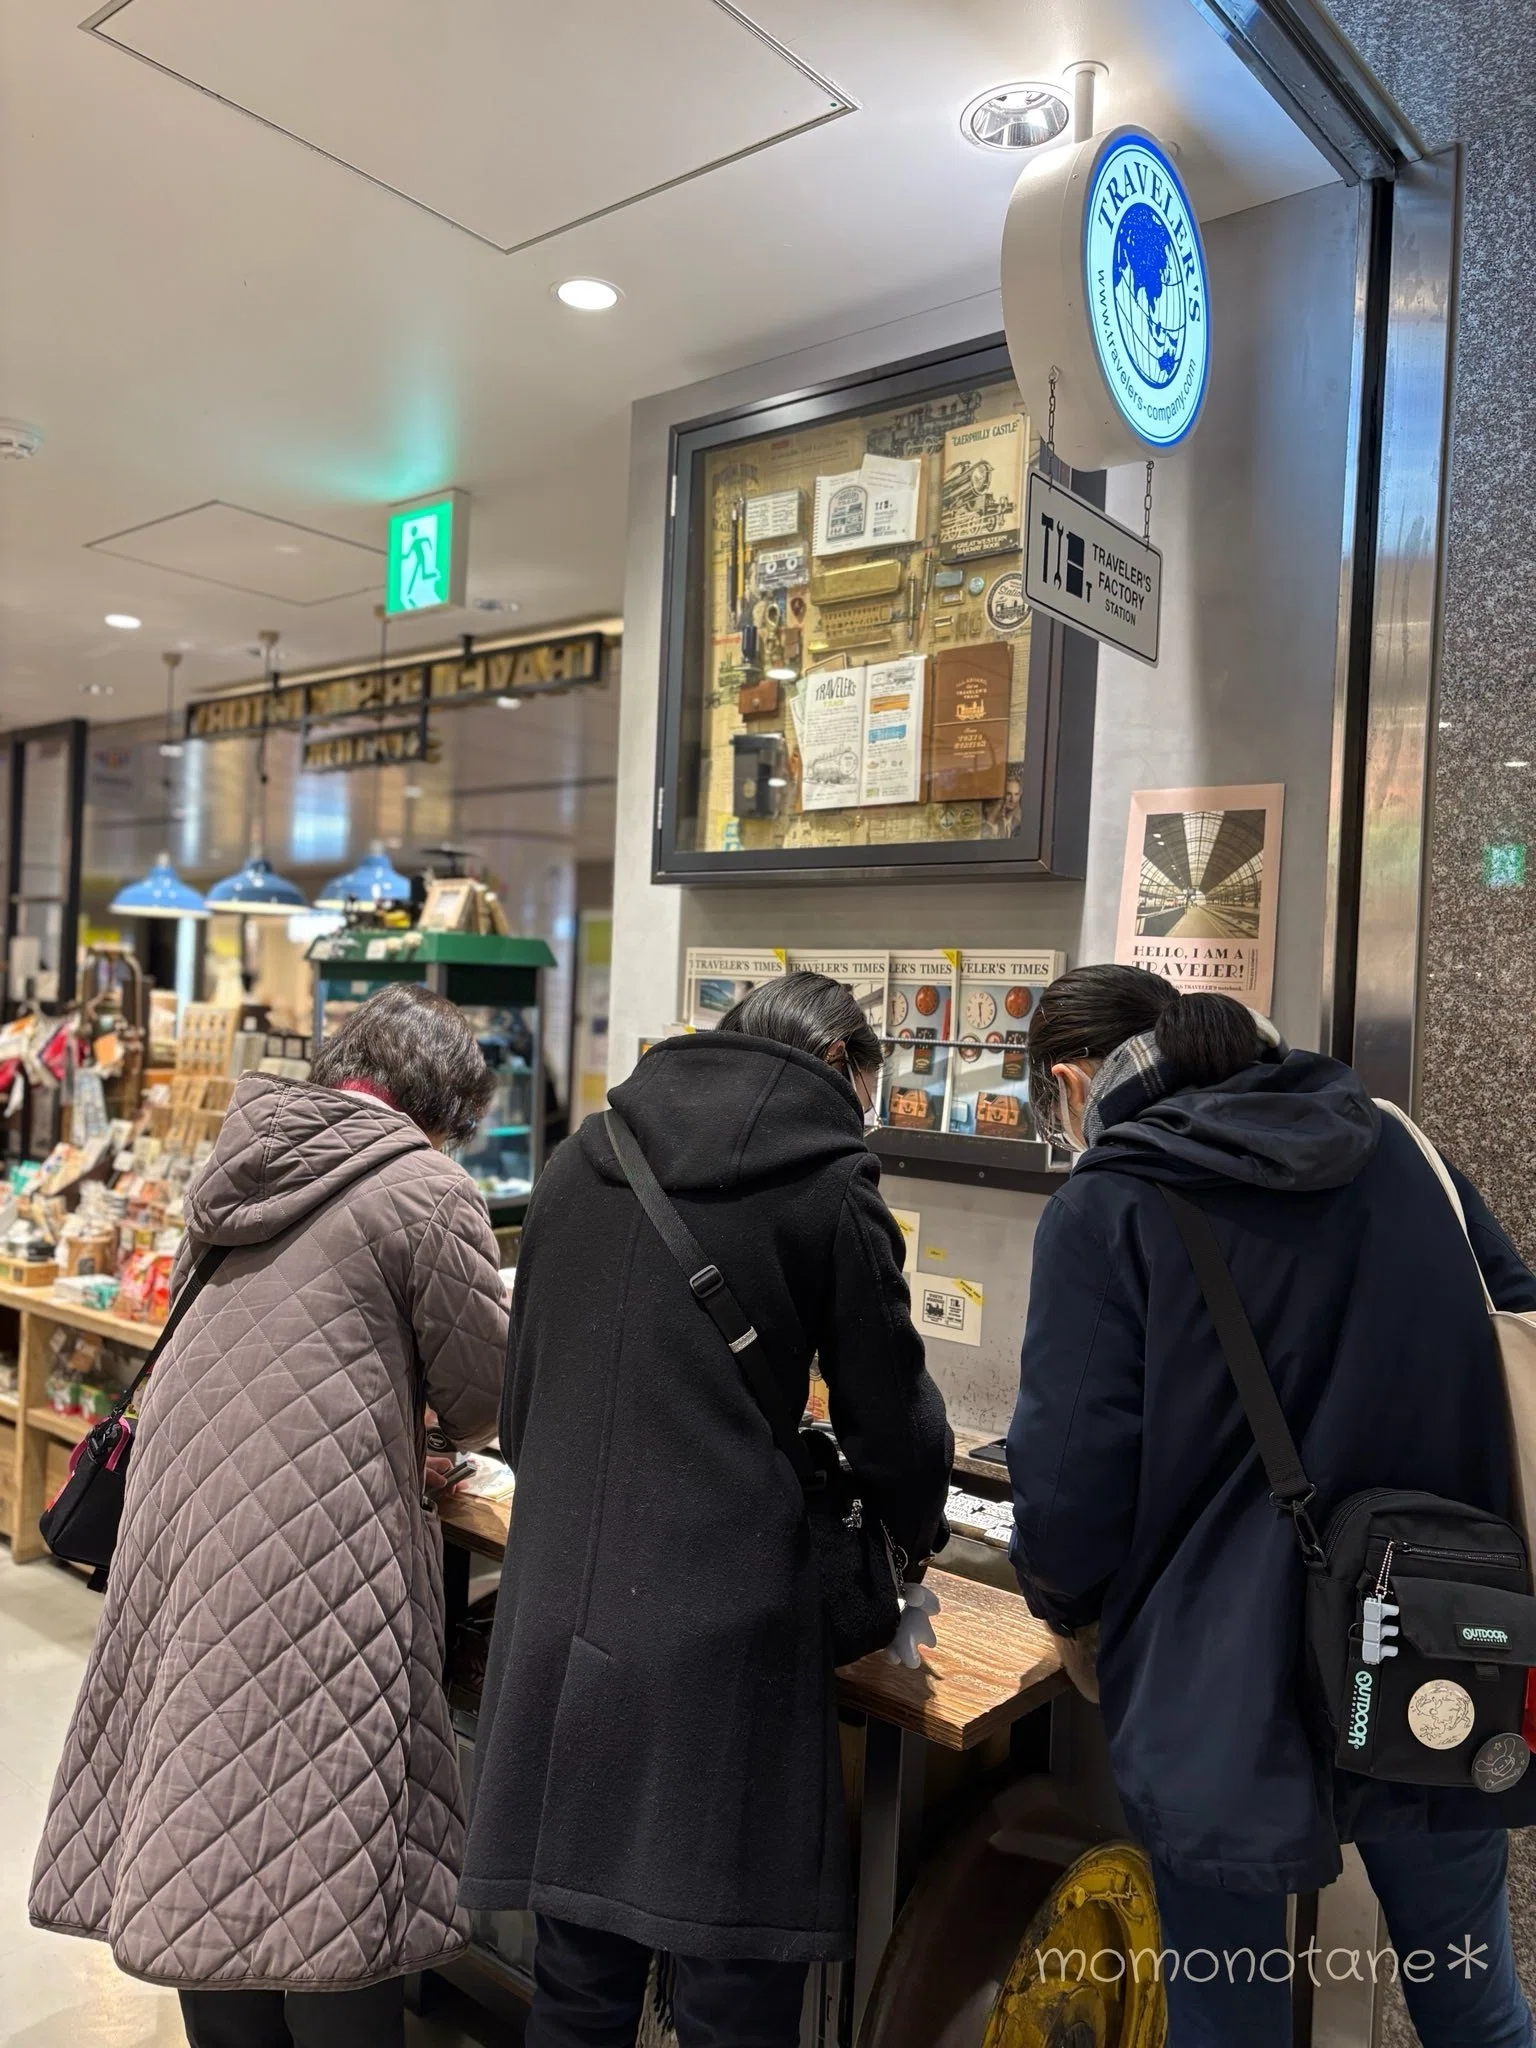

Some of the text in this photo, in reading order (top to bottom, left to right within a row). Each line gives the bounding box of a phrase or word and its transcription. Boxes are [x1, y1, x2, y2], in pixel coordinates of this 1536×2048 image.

[1098, 161, 1201, 322] TRAVELER'S
[1098, 269, 1197, 424] www.travelers-company.com
[1092, 543, 1151, 593] TRAVELER'S
[1099, 571, 1145, 611] FACTORY
[1105, 598, 1136, 626] STATION
[1133, 946, 1244, 960] HELLO, I AM A
[695, 959, 783, 973] TRAVELER'S TIMES
[788, 962, 885, 974] TRAVELER'S TIMES
[920, 963, 952, 975] TIMES
[1010, 963, 1049, 975] TIMES
[1131, 961, 1244, 978] TRAVELER!
[1462, 1627, 1507, 1643] OUTDOOR
[1348, 1670, 1373, 1747] OUTDOOR
